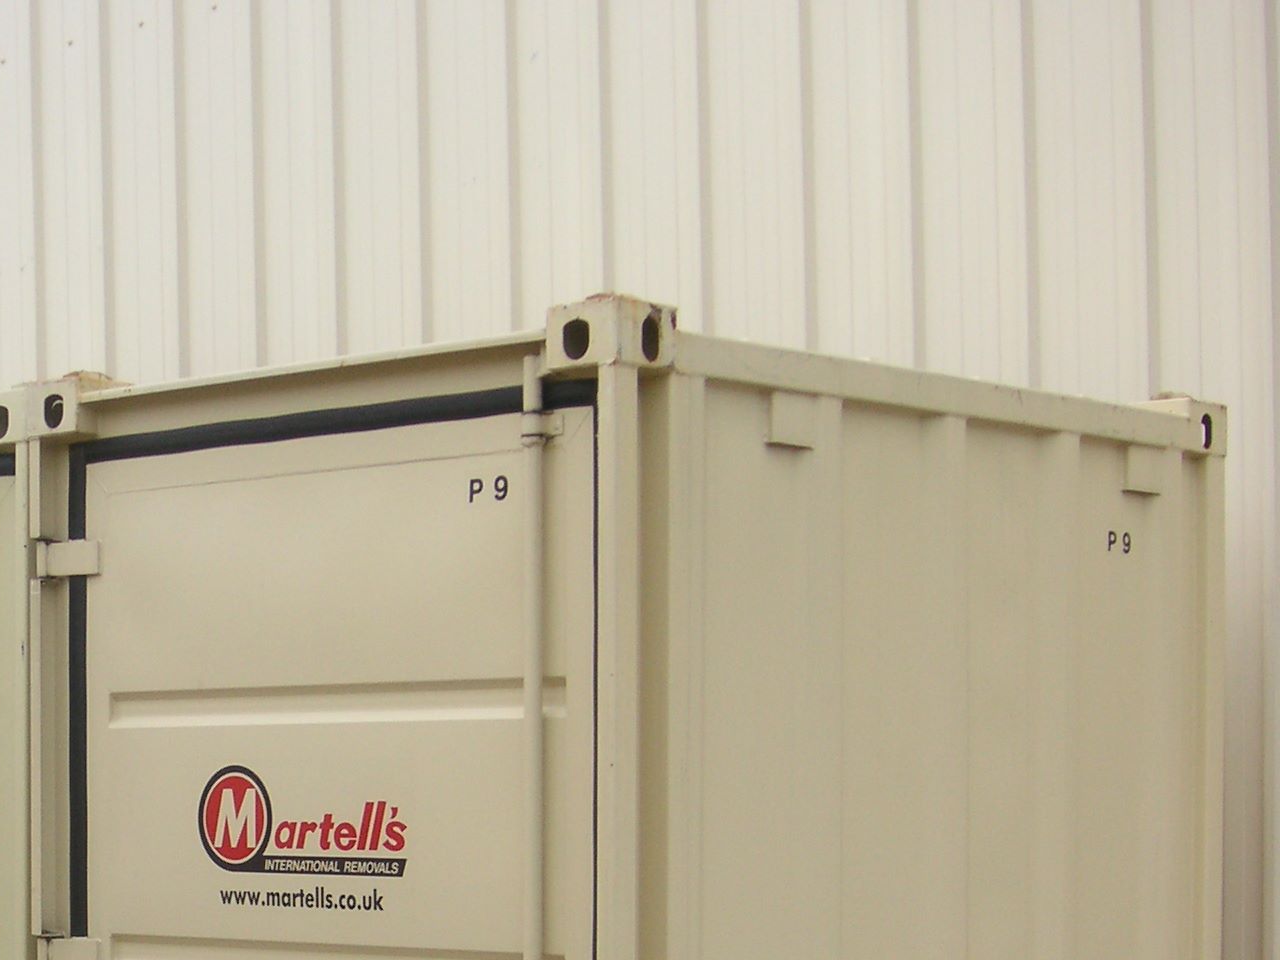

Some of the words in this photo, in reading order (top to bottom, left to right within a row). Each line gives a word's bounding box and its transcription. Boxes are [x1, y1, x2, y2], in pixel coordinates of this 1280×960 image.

[469, 478, 484, 503] P
[494, 475, 508, 501] 9
[1108, 530, 1117, 552] P
[1122, 532, 1131, 554] 9
[213, 788, 408, 852] Martell's
[264, 858, 341, 873] INTERNATIONAL
[343, 861, 400, 875] REMOVALS
[220, 886, 385, 912] www.martells.co.uk
